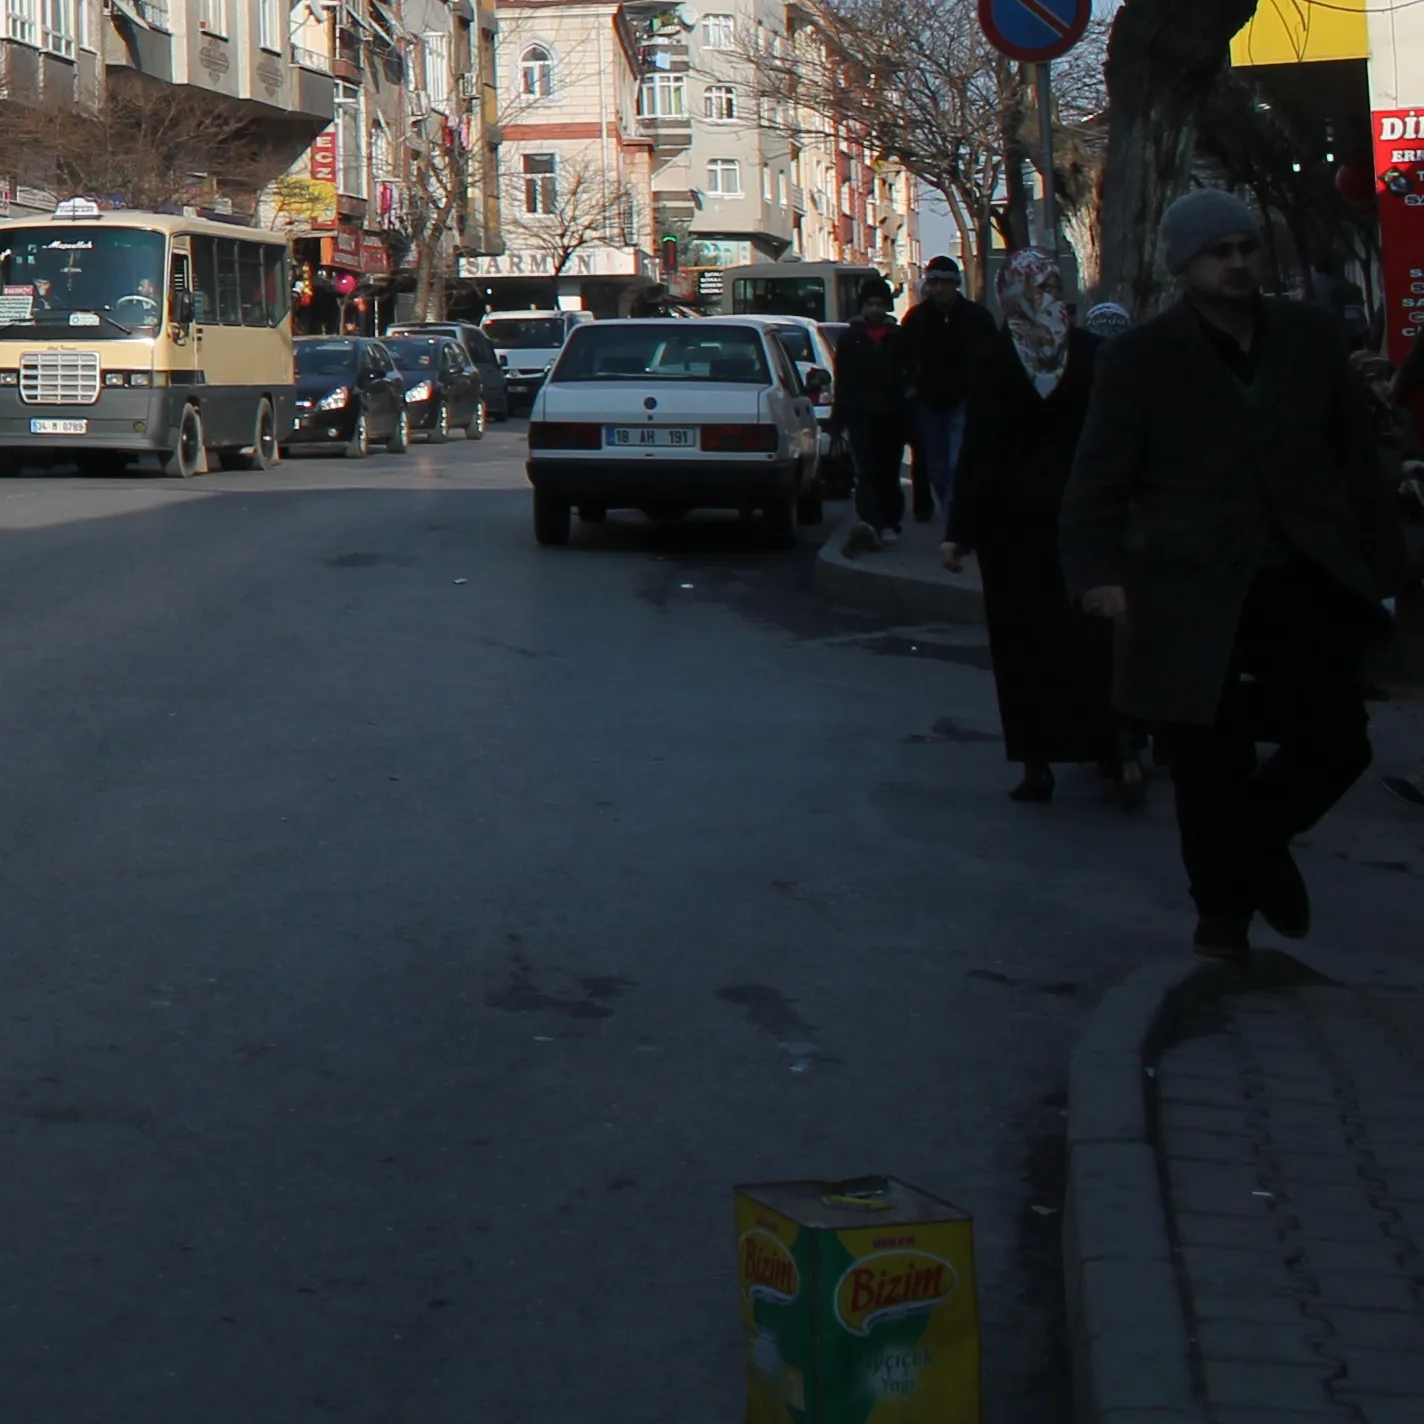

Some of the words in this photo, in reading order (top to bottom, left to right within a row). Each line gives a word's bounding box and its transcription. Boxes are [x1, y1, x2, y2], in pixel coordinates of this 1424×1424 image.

[616, 429, 629, 444] 18
[639, 429, 655, 444] AH
[669, 430, 688, 444] 191
[744, 1238, 794, 1296] Bizim
[851, 1261, 944, 1313] Bizim
